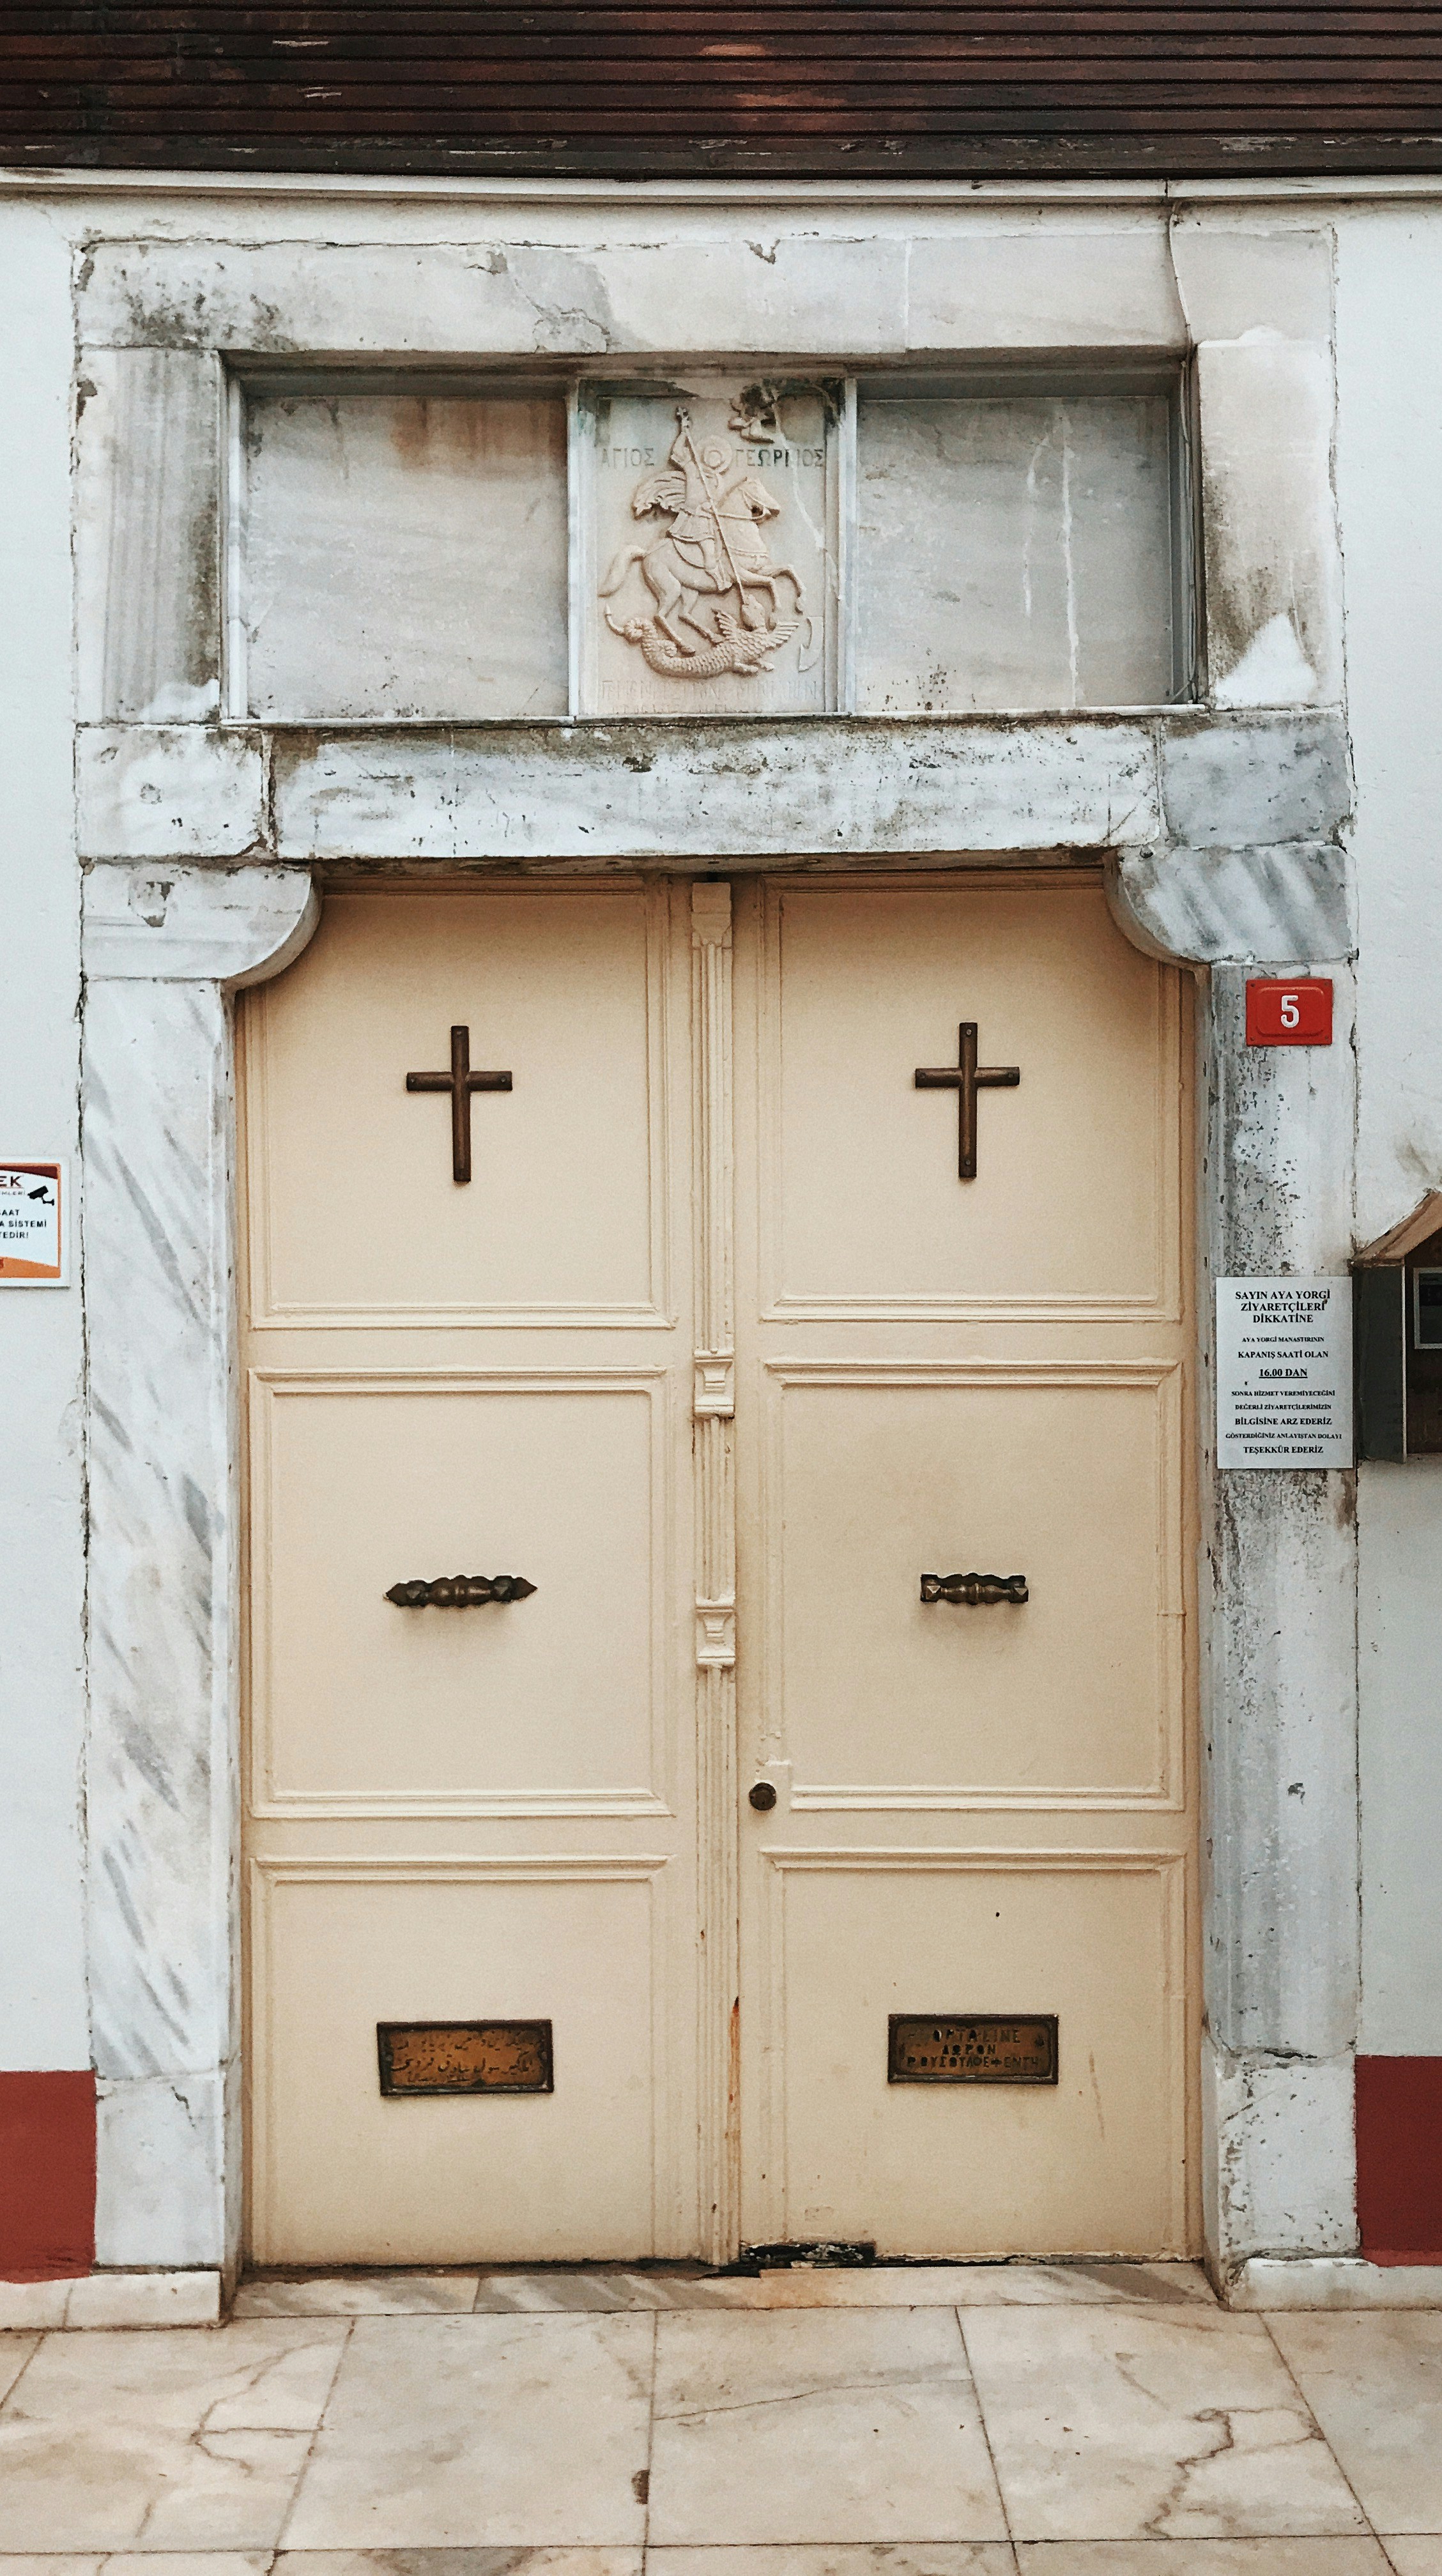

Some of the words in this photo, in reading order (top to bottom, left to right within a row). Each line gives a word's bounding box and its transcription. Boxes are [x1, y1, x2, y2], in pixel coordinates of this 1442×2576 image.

[1281, 995, 1300, 1028] 5
[9, 1219, 47, 1227] SİSTEMİ
[1235, 1291, 1268, 1300] SAYIN
[1296, 1289, 1330, 1299] YORGİ
[1241, 1301, 1325, 1312] ZİYARETÇİLERİ
[1253, 1313, 1314, 1323] DİKKATİNE
[1238, 1351, 1275, 1360] KAPANIŞ
[1277, 1350, 1302, 1358] SAATİ
[1285, 1368, 1308, 1377] DAN
[1300, 1417, 1332, 1425] EDERİZ
[1243, 1446, 1289, 1455] TEŞEKKÜR
[1291, 1445, 1323, 1453] EDERİZ
